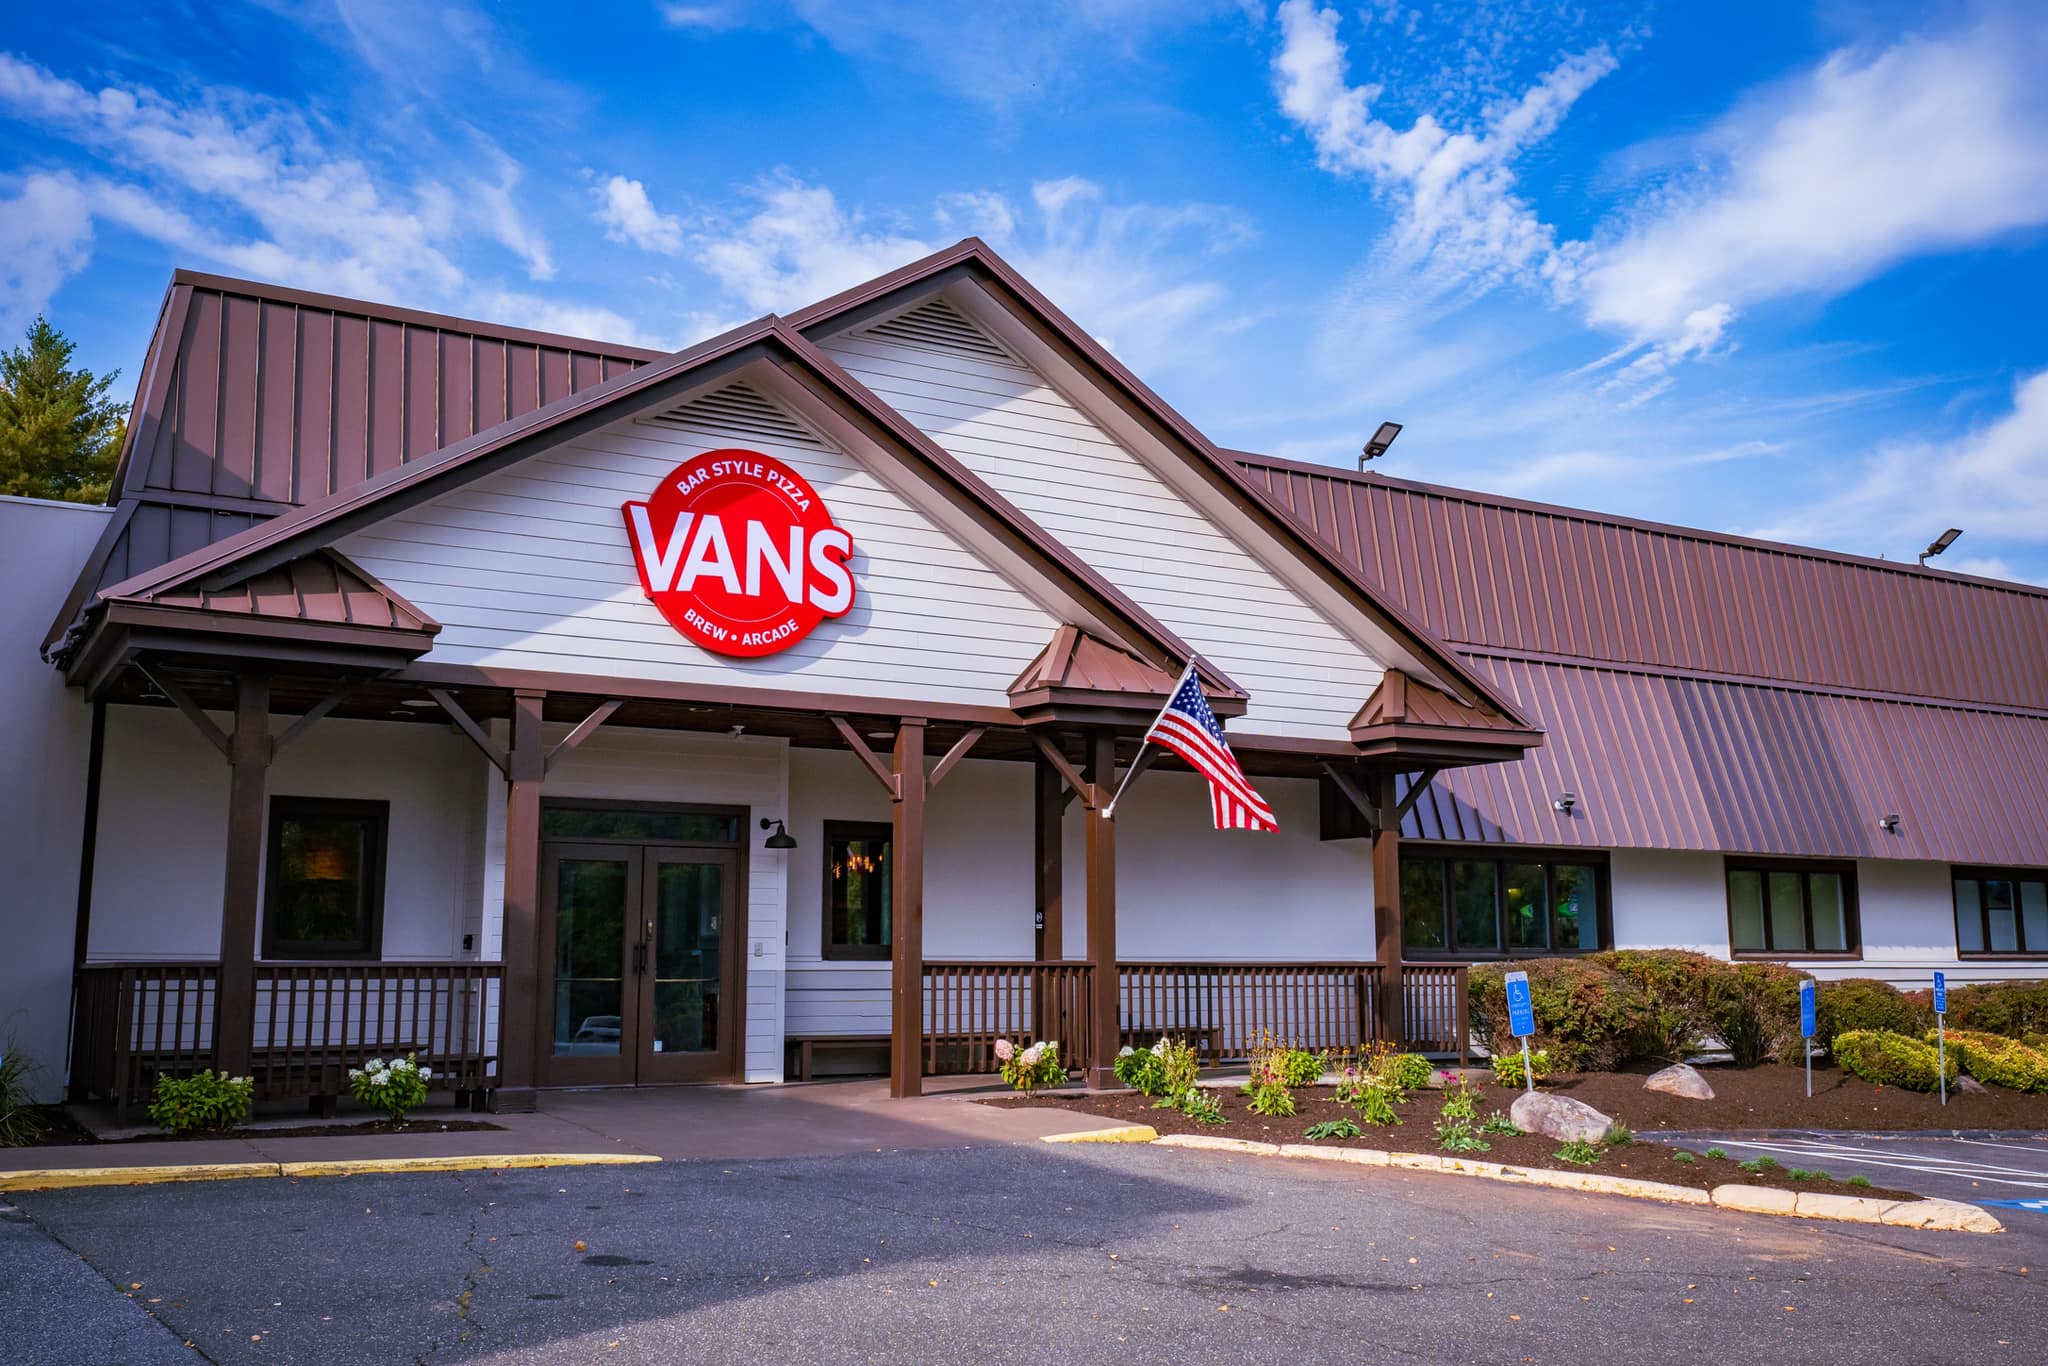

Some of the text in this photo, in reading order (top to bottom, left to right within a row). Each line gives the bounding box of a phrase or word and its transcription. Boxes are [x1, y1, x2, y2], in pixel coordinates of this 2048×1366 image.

[676, 460, 811, 513] BAR STYLE PIZZA
[629, 504, 852, 614] VANS
[684, 608, 800, 646] BREW ARCADE
